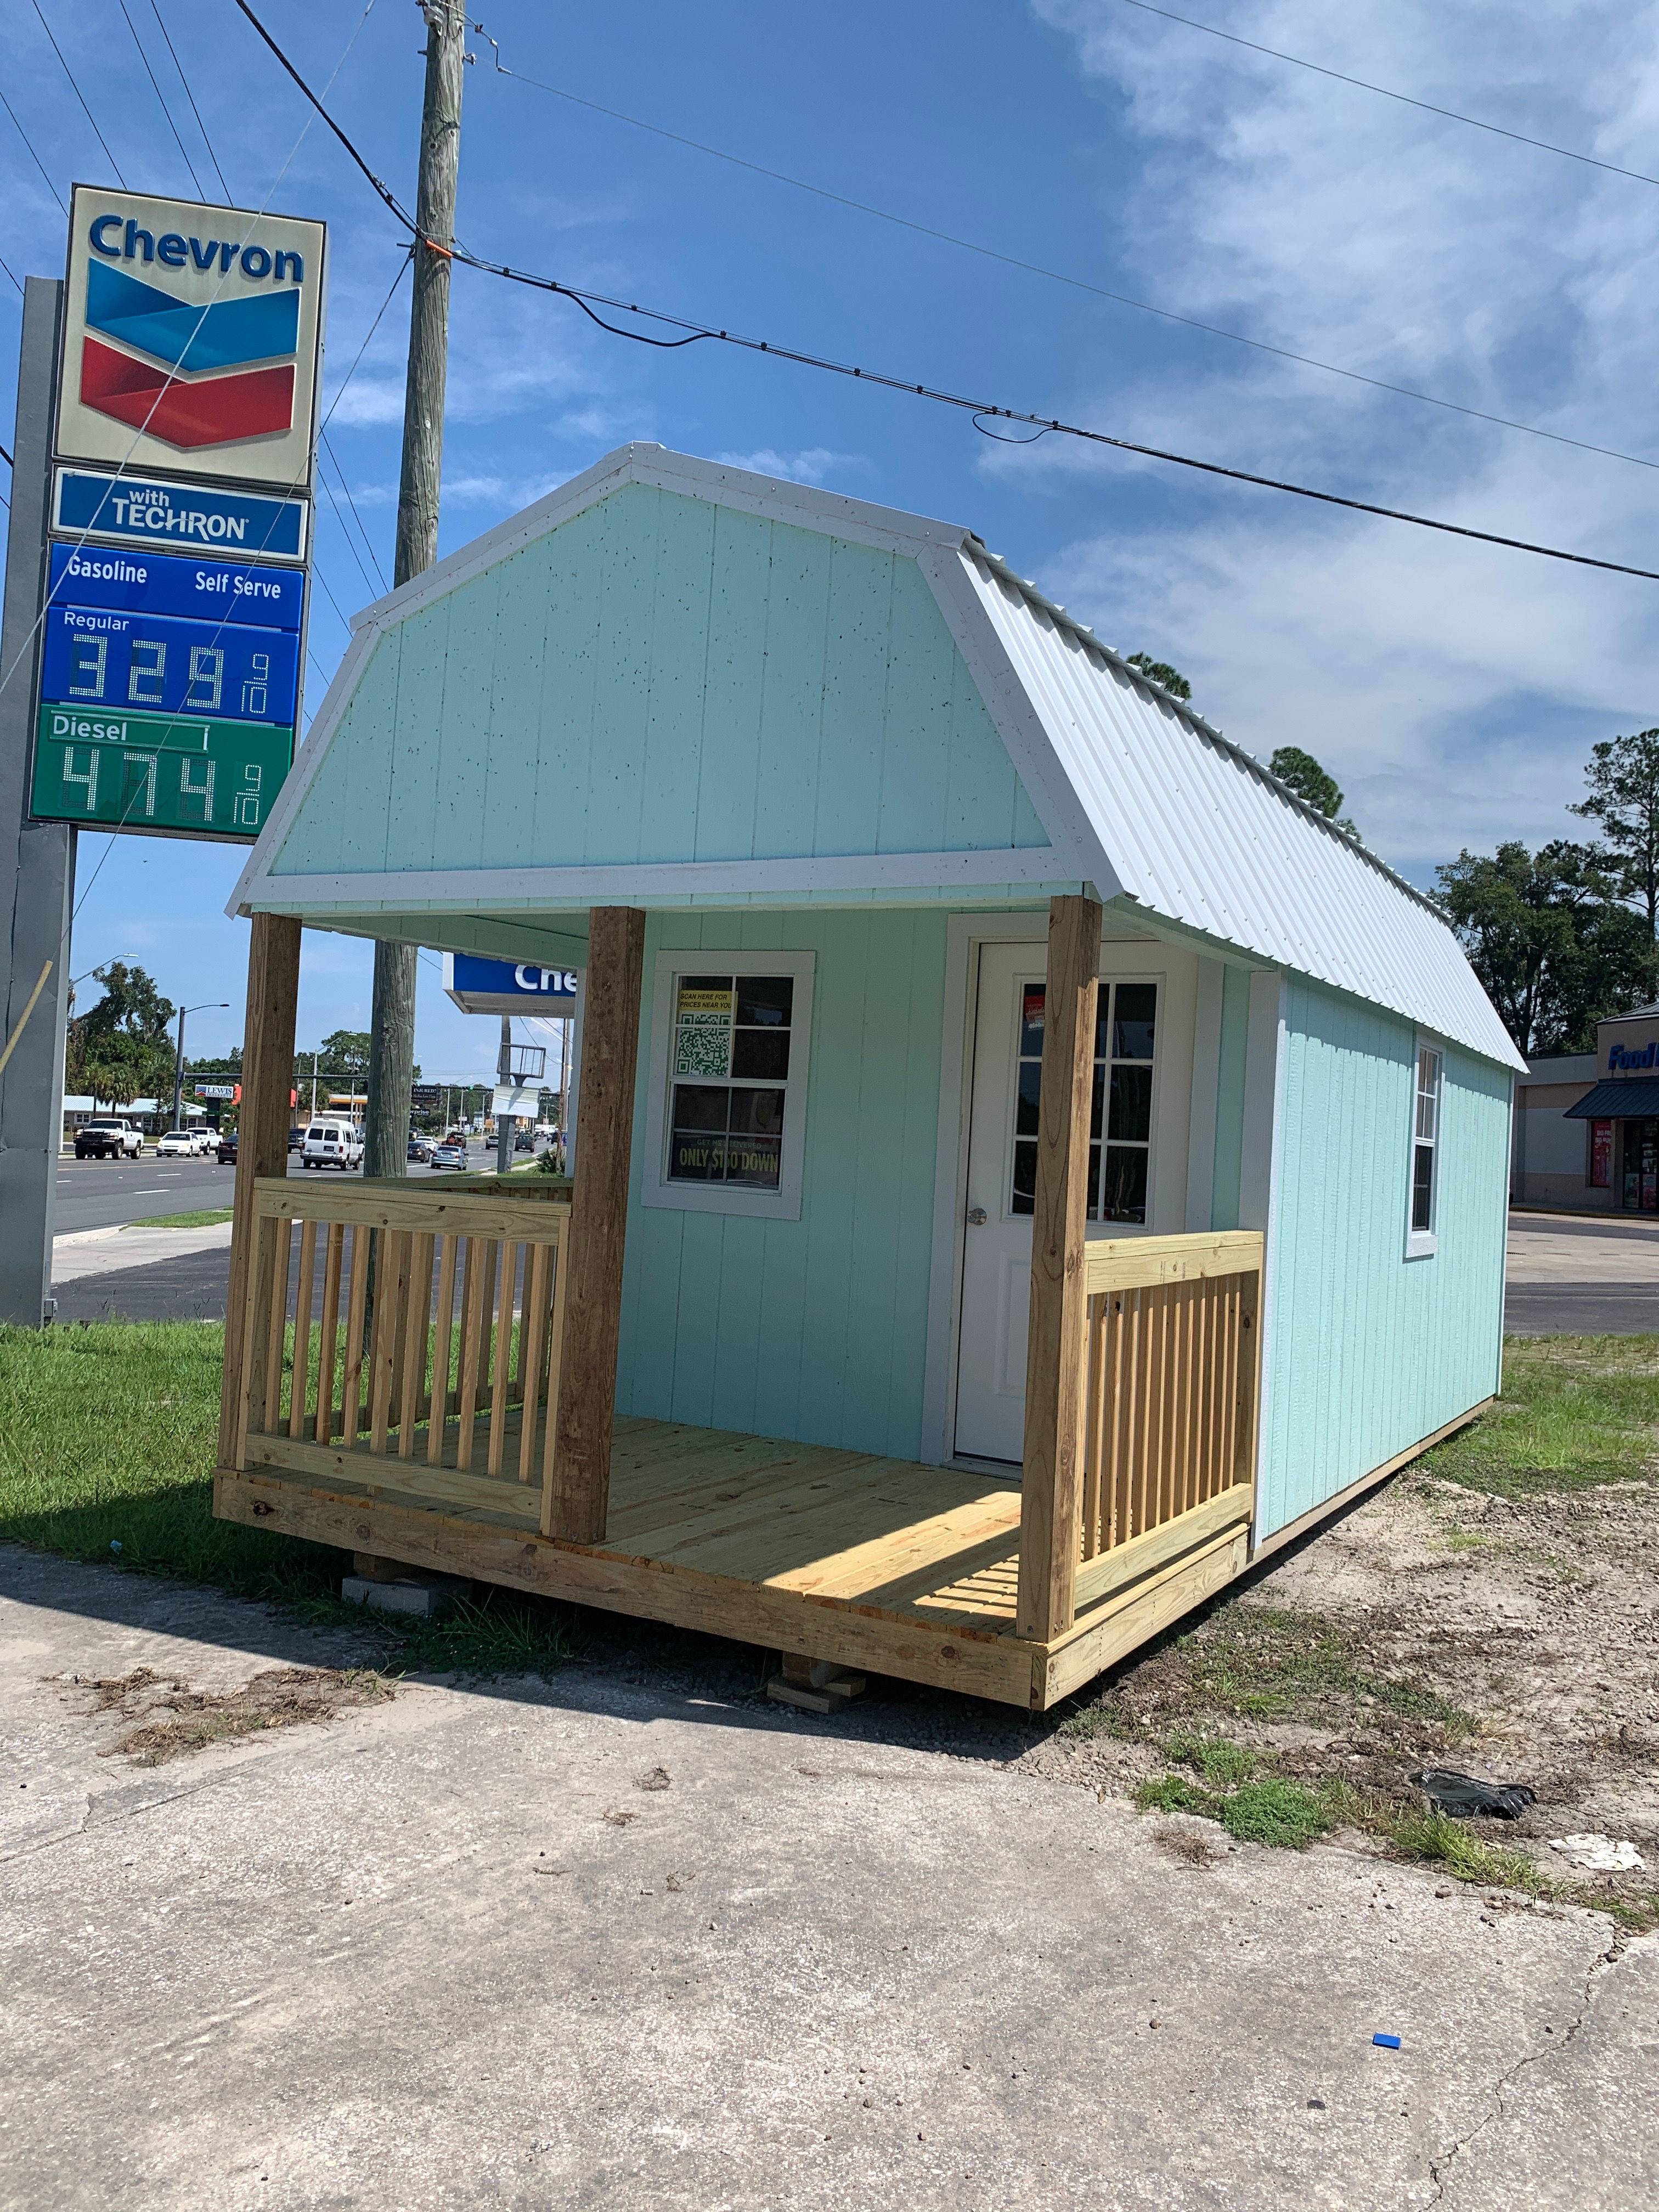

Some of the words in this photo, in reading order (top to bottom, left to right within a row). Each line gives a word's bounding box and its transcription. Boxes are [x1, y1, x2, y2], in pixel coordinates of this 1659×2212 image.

[89, 215, 304, 283] Chevron
[129, 489, 170, 507] with
[69, 556, 148, 584] Gasoline
[195, 571, 229, 594] Self
[234, 575, 281, 599] Serve
[64, 611, 129, 631] Regular
[53, 717, 127, 741] Diesel
[1608, 1043, 1655, 1070] Food
[724, 1141, 762, 1149] ELIVERED
[679, 1148, 709, 1167] ONLY
[712, 1148, 738, 1171] $10
[742, 1152, 778, 1172] DOWN
